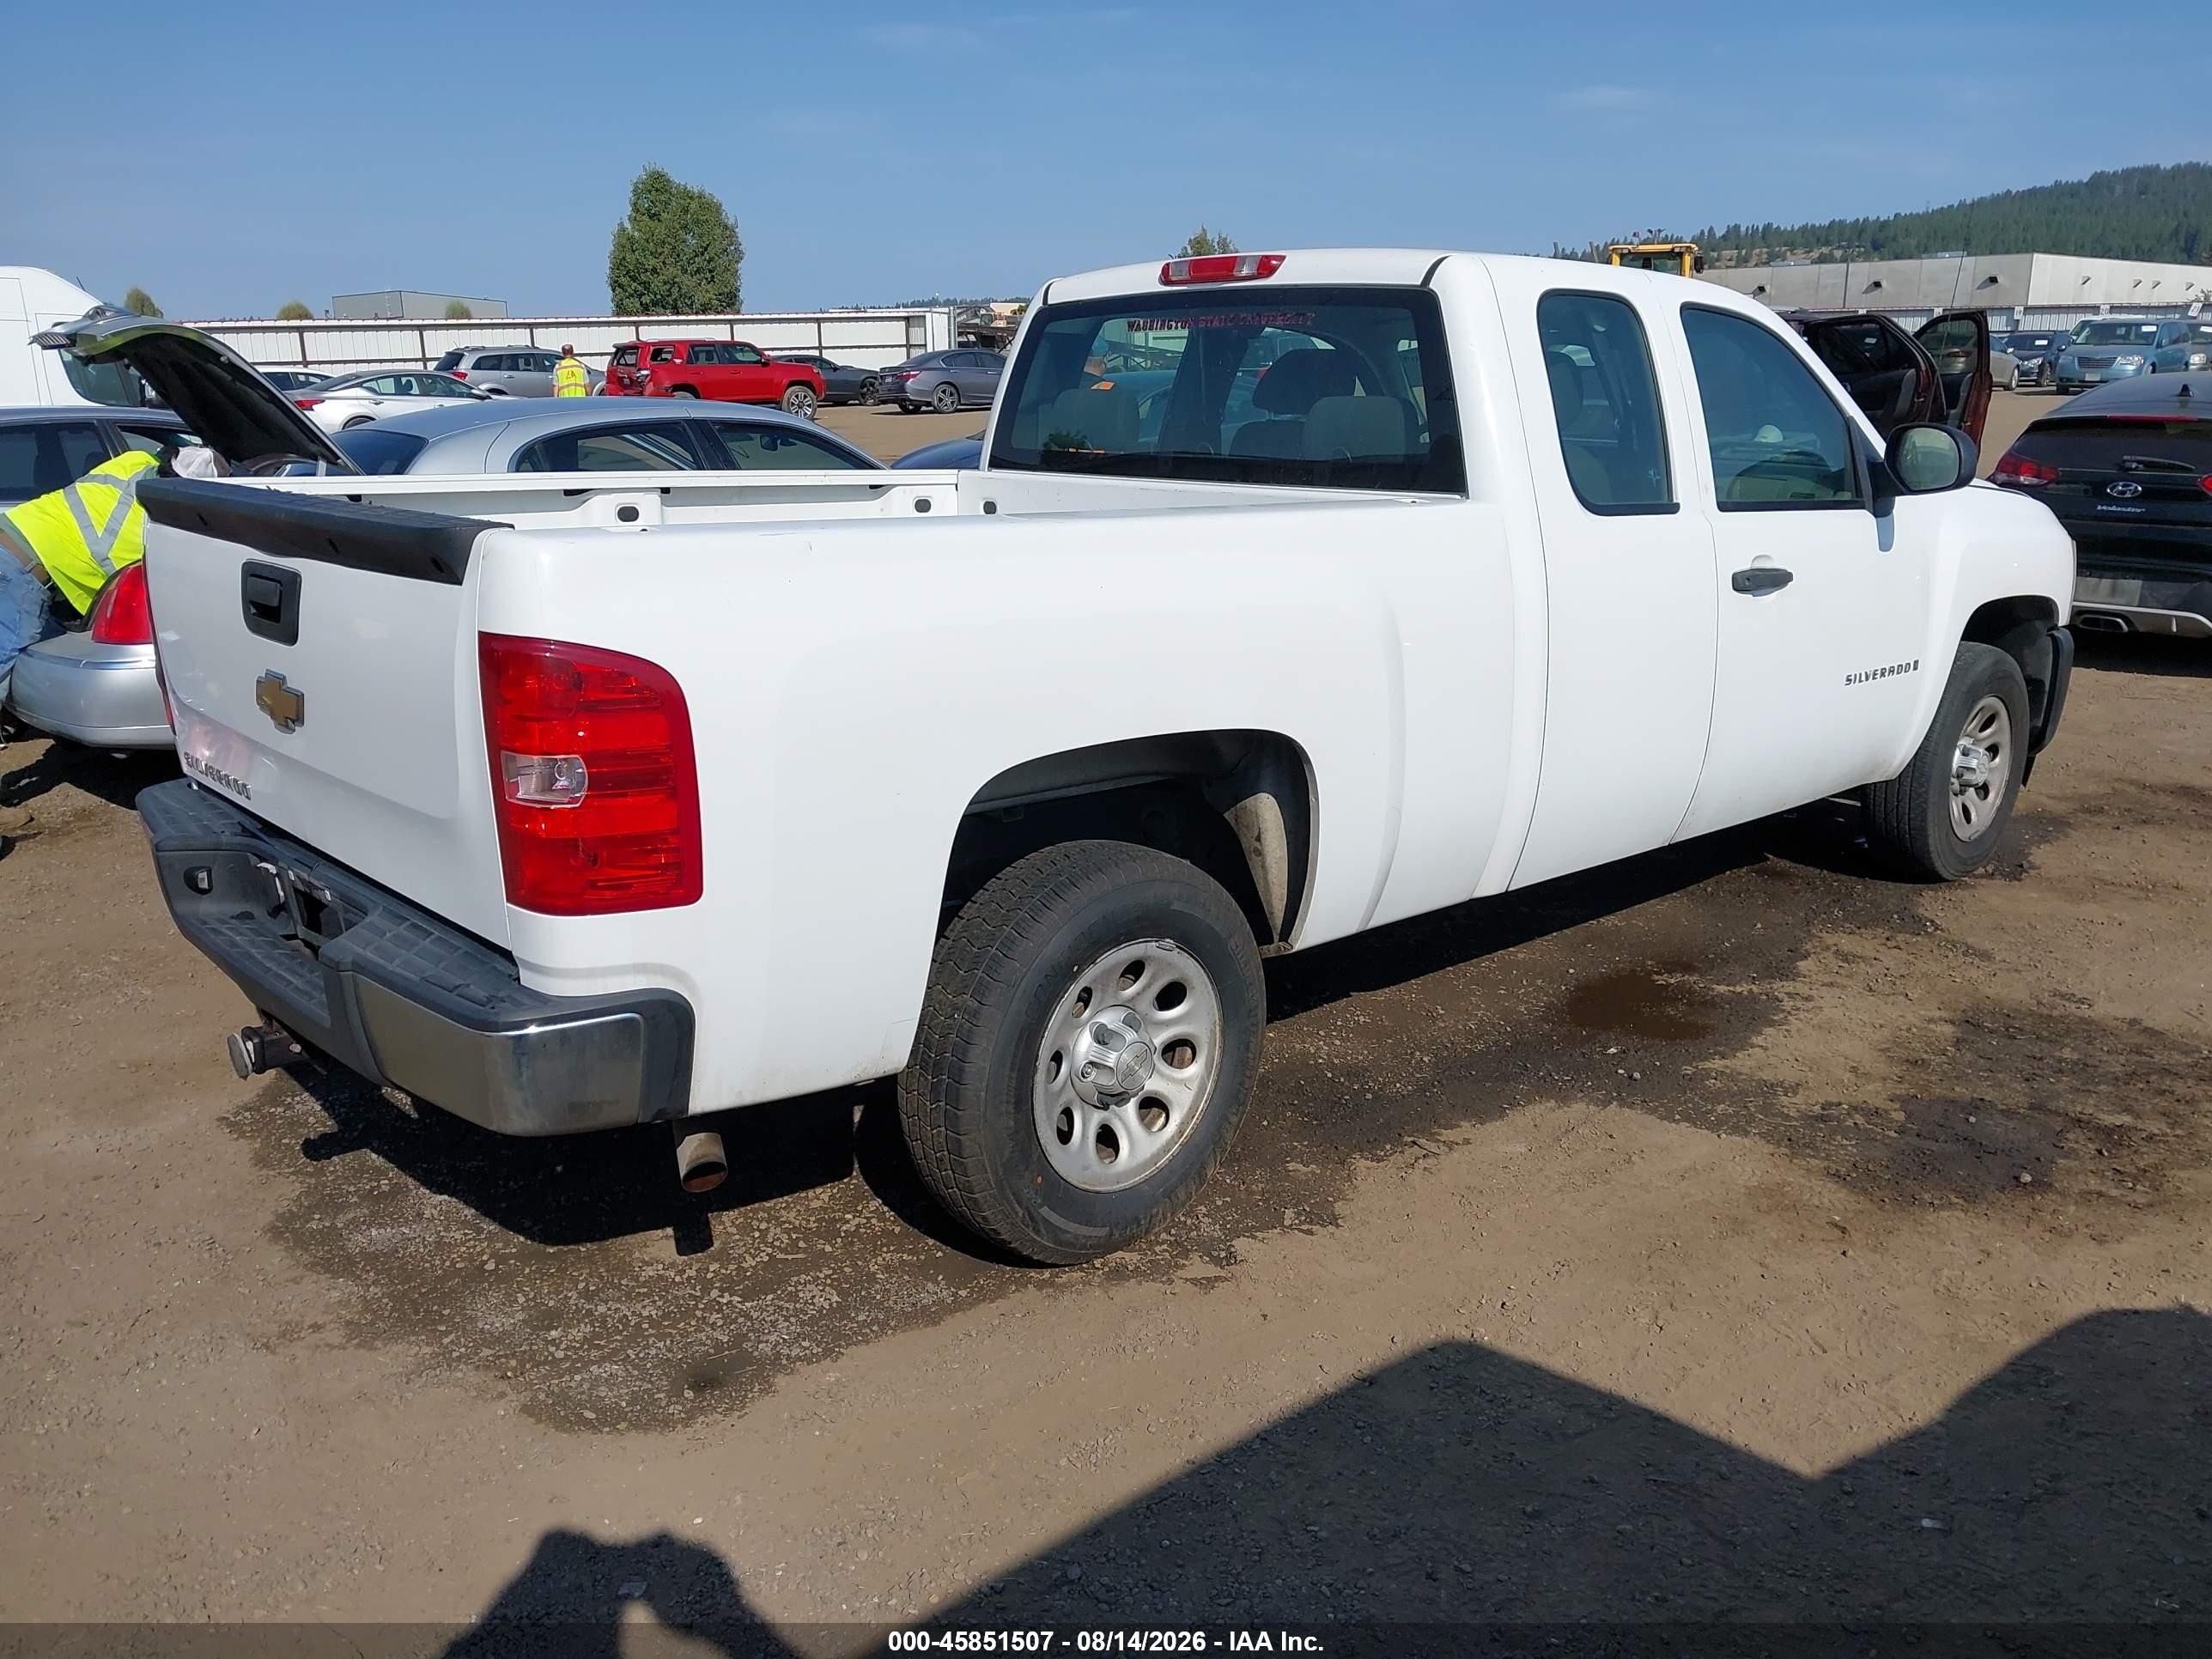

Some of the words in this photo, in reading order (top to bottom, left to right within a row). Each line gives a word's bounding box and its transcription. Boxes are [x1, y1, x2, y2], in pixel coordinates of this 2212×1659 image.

[1127, 317, 1194, 332] WASHINGTON
[1844, 661, 1911, 686] SILVERADO
[184, 751, 252, 801] SILVERADO
